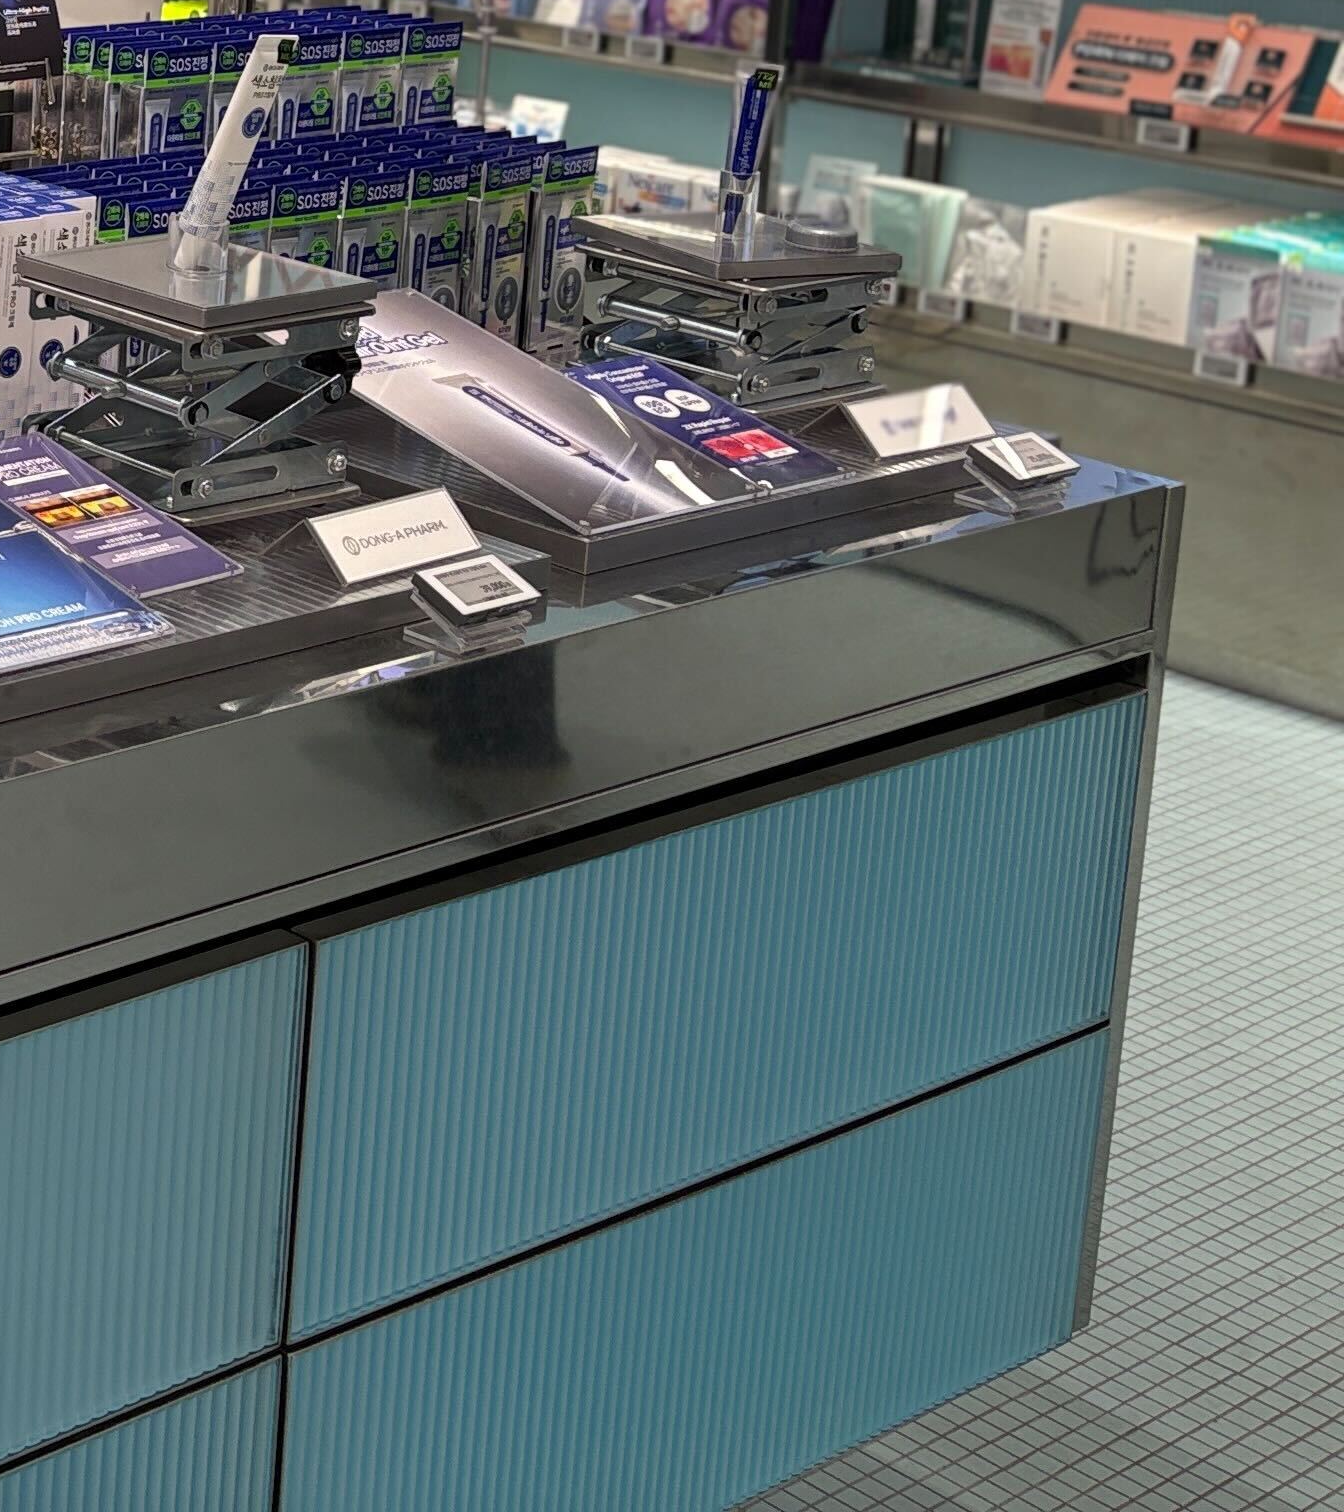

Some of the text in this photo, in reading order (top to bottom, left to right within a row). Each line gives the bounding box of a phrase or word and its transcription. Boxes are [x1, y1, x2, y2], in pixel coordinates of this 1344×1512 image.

[23, 462, 64, 477] CREAM
[359, 519, 449, 550] DONG-A PHARM.
[13, 610, 43, 627] PRO
[41, 601, 89, 619] CREAM
